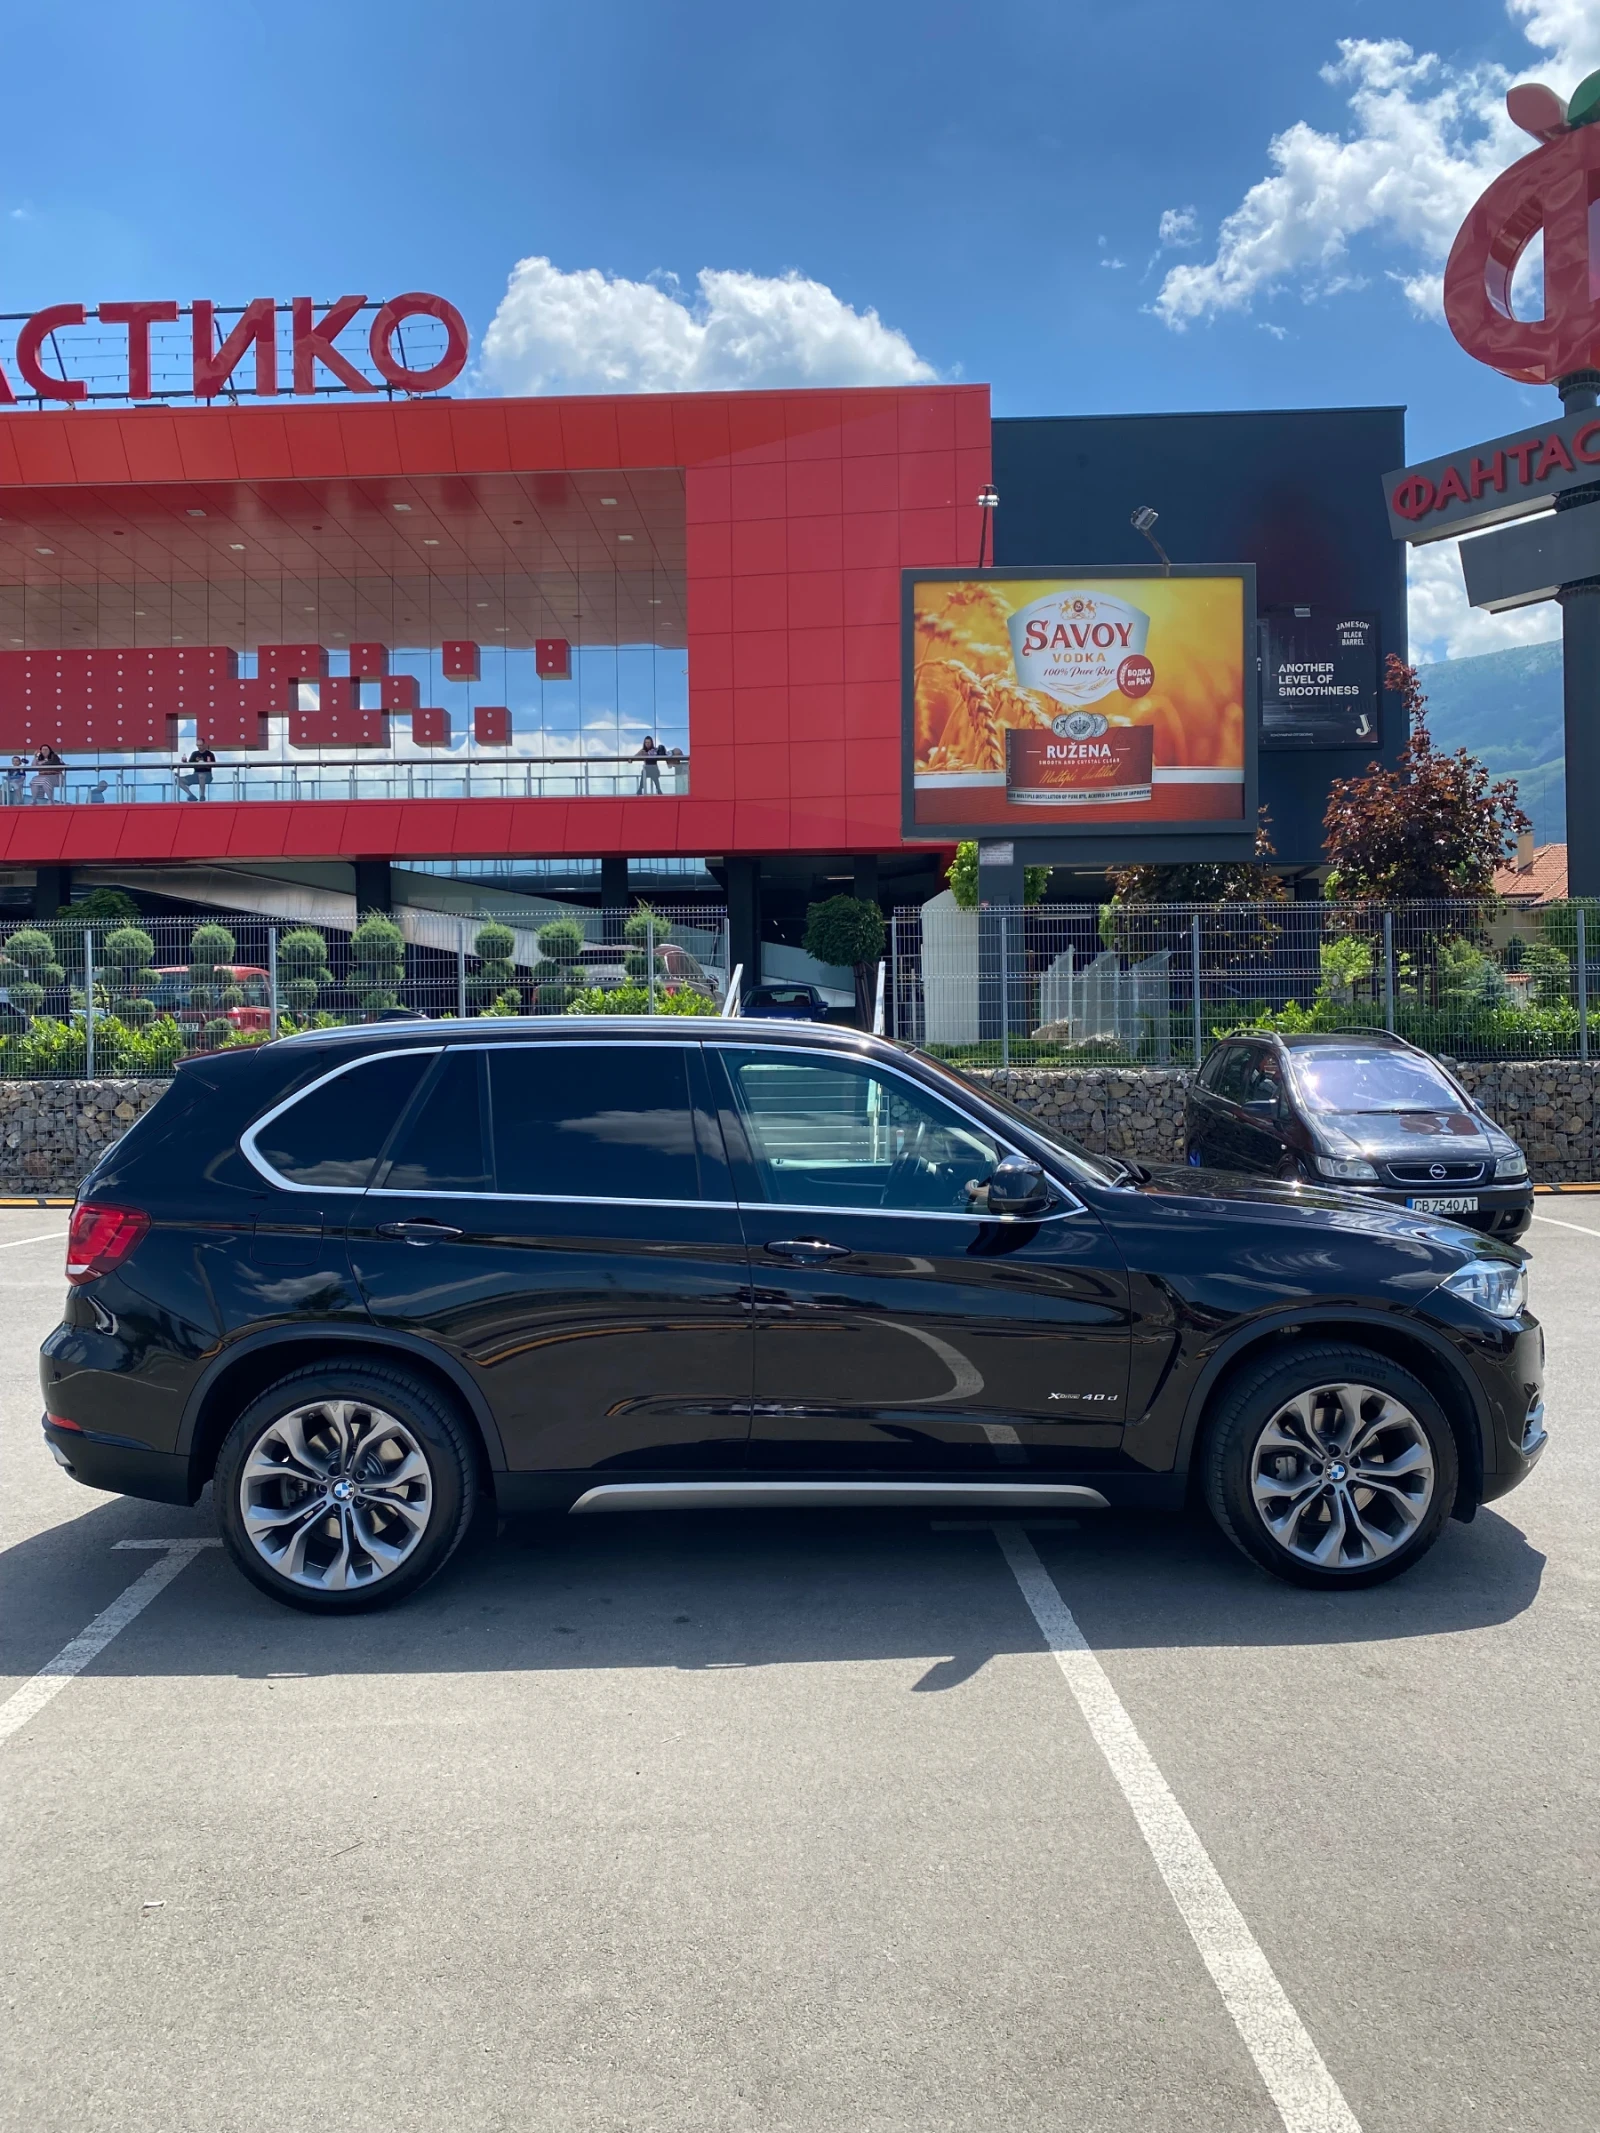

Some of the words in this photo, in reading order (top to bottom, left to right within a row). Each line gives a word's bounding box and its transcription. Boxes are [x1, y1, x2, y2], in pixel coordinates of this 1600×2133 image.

[0, 292, 469, 404] СТИКО
[1391, 419, 1600, 522] ФАНТАС
[1336, 620, 1369, 631] JAMESON
[1022, 620, 1134, 657] SAVOY
[1341, 638, 1365, 646] BARREL
[1052, 653, 1106, 663] VODKA
[1043, 668, 1069, 676] 100%
[1069, 666, 1094, 678] Pure
[1095, 666, 1116, 677] Rye
[1127, 669, 1151, 677] ВОДКА
[1278, 663, 1334, 673] ANOTHER
[1278, 675, 1315, 685] LEVEL
[1317, 674, 1333, 684] OF
[1278, 686, 1360, 697] SMOOTHNESS
[1046, 742, 1111, 759] RUŽENA
[1414, 1200, 1429, 1212] CB
[1432, 1200, 1460, 1211] 7540
[1462, 1199, 1477, 1211] AT
